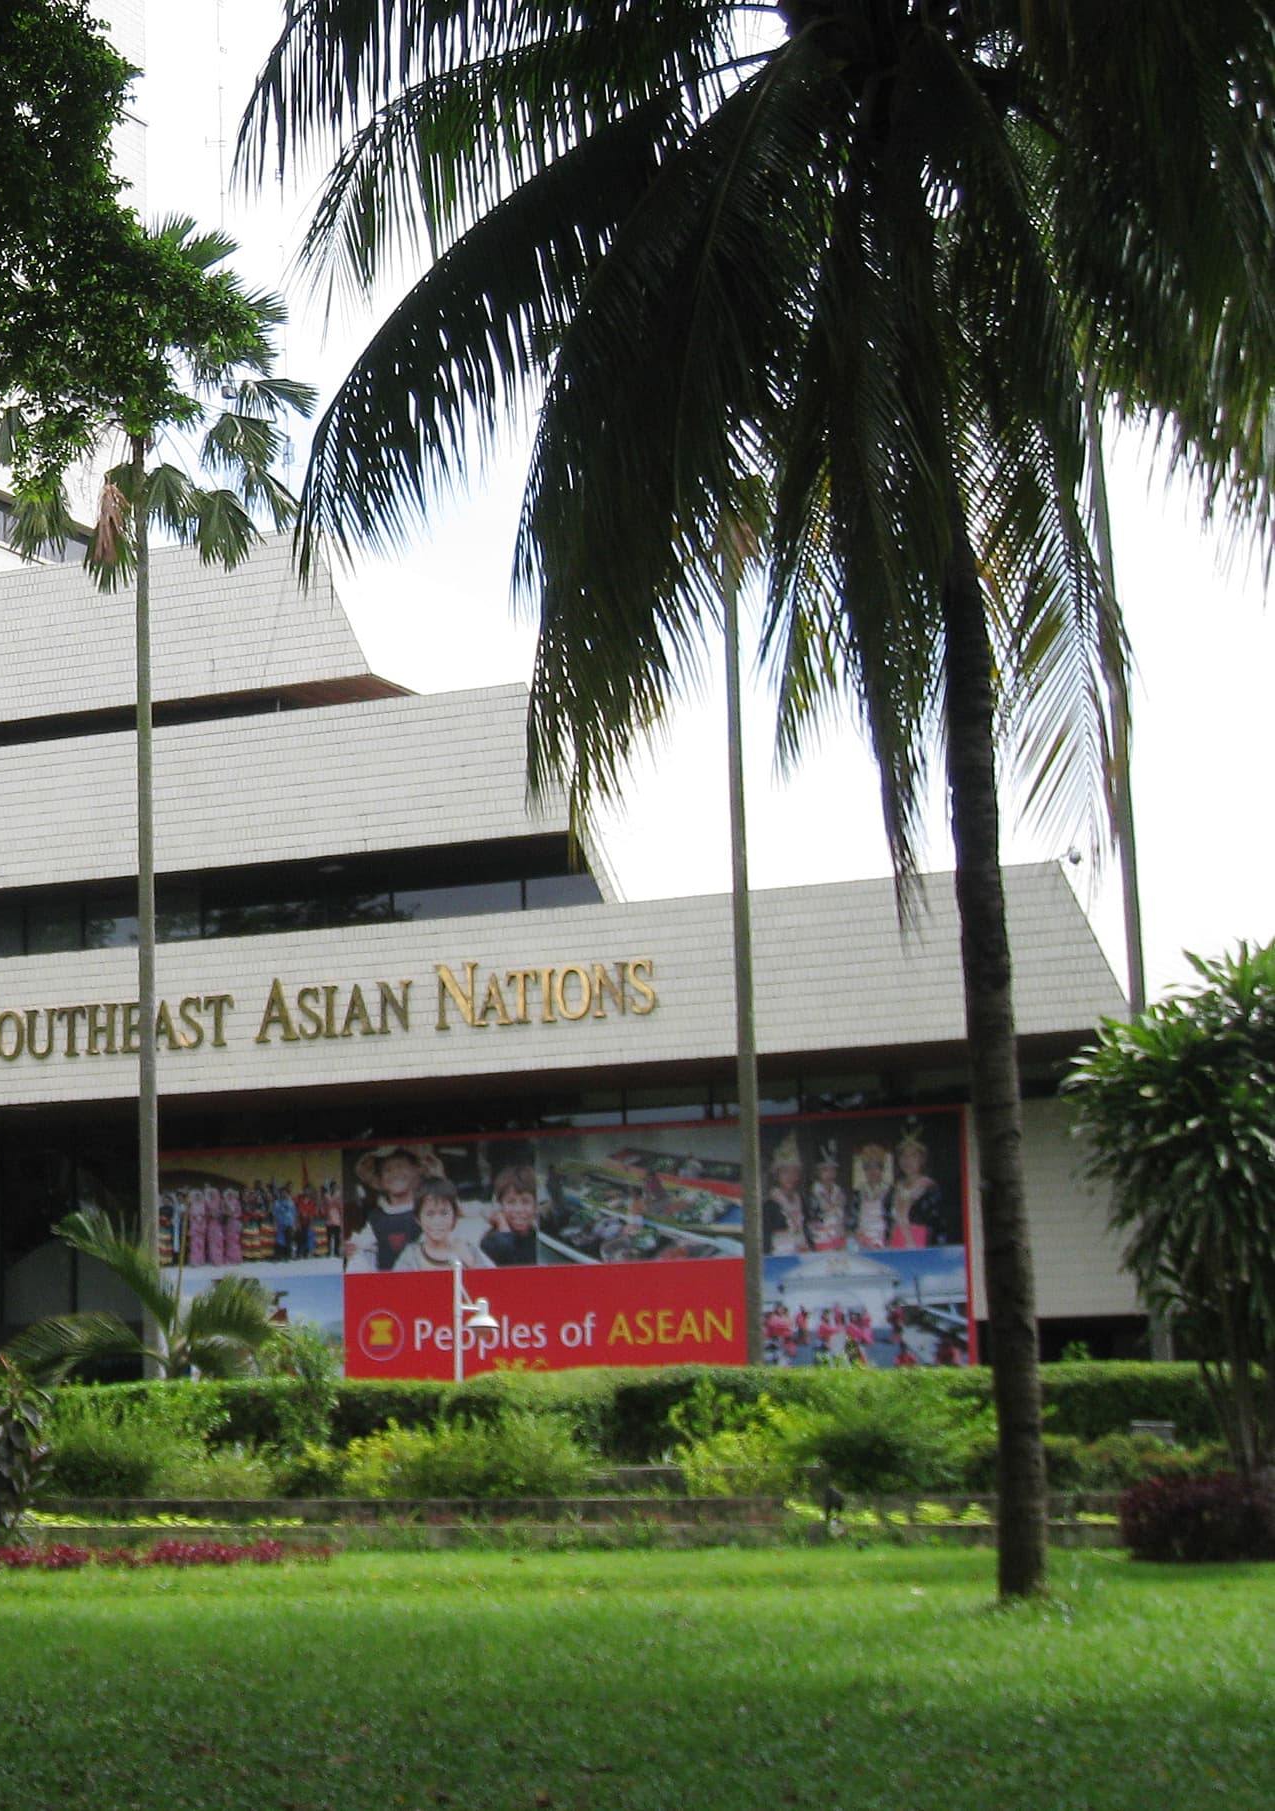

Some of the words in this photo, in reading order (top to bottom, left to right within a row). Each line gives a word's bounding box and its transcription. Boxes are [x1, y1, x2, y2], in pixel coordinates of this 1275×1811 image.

[255, 977, 413, 1044] ASIAN
[434, 960, 656, 1031] NATIONS
[413, 1315, 548, 1360] Peoples
[560, 1311, 596, 1348] of
[608, 1308, 734, 1346] ASEAN
